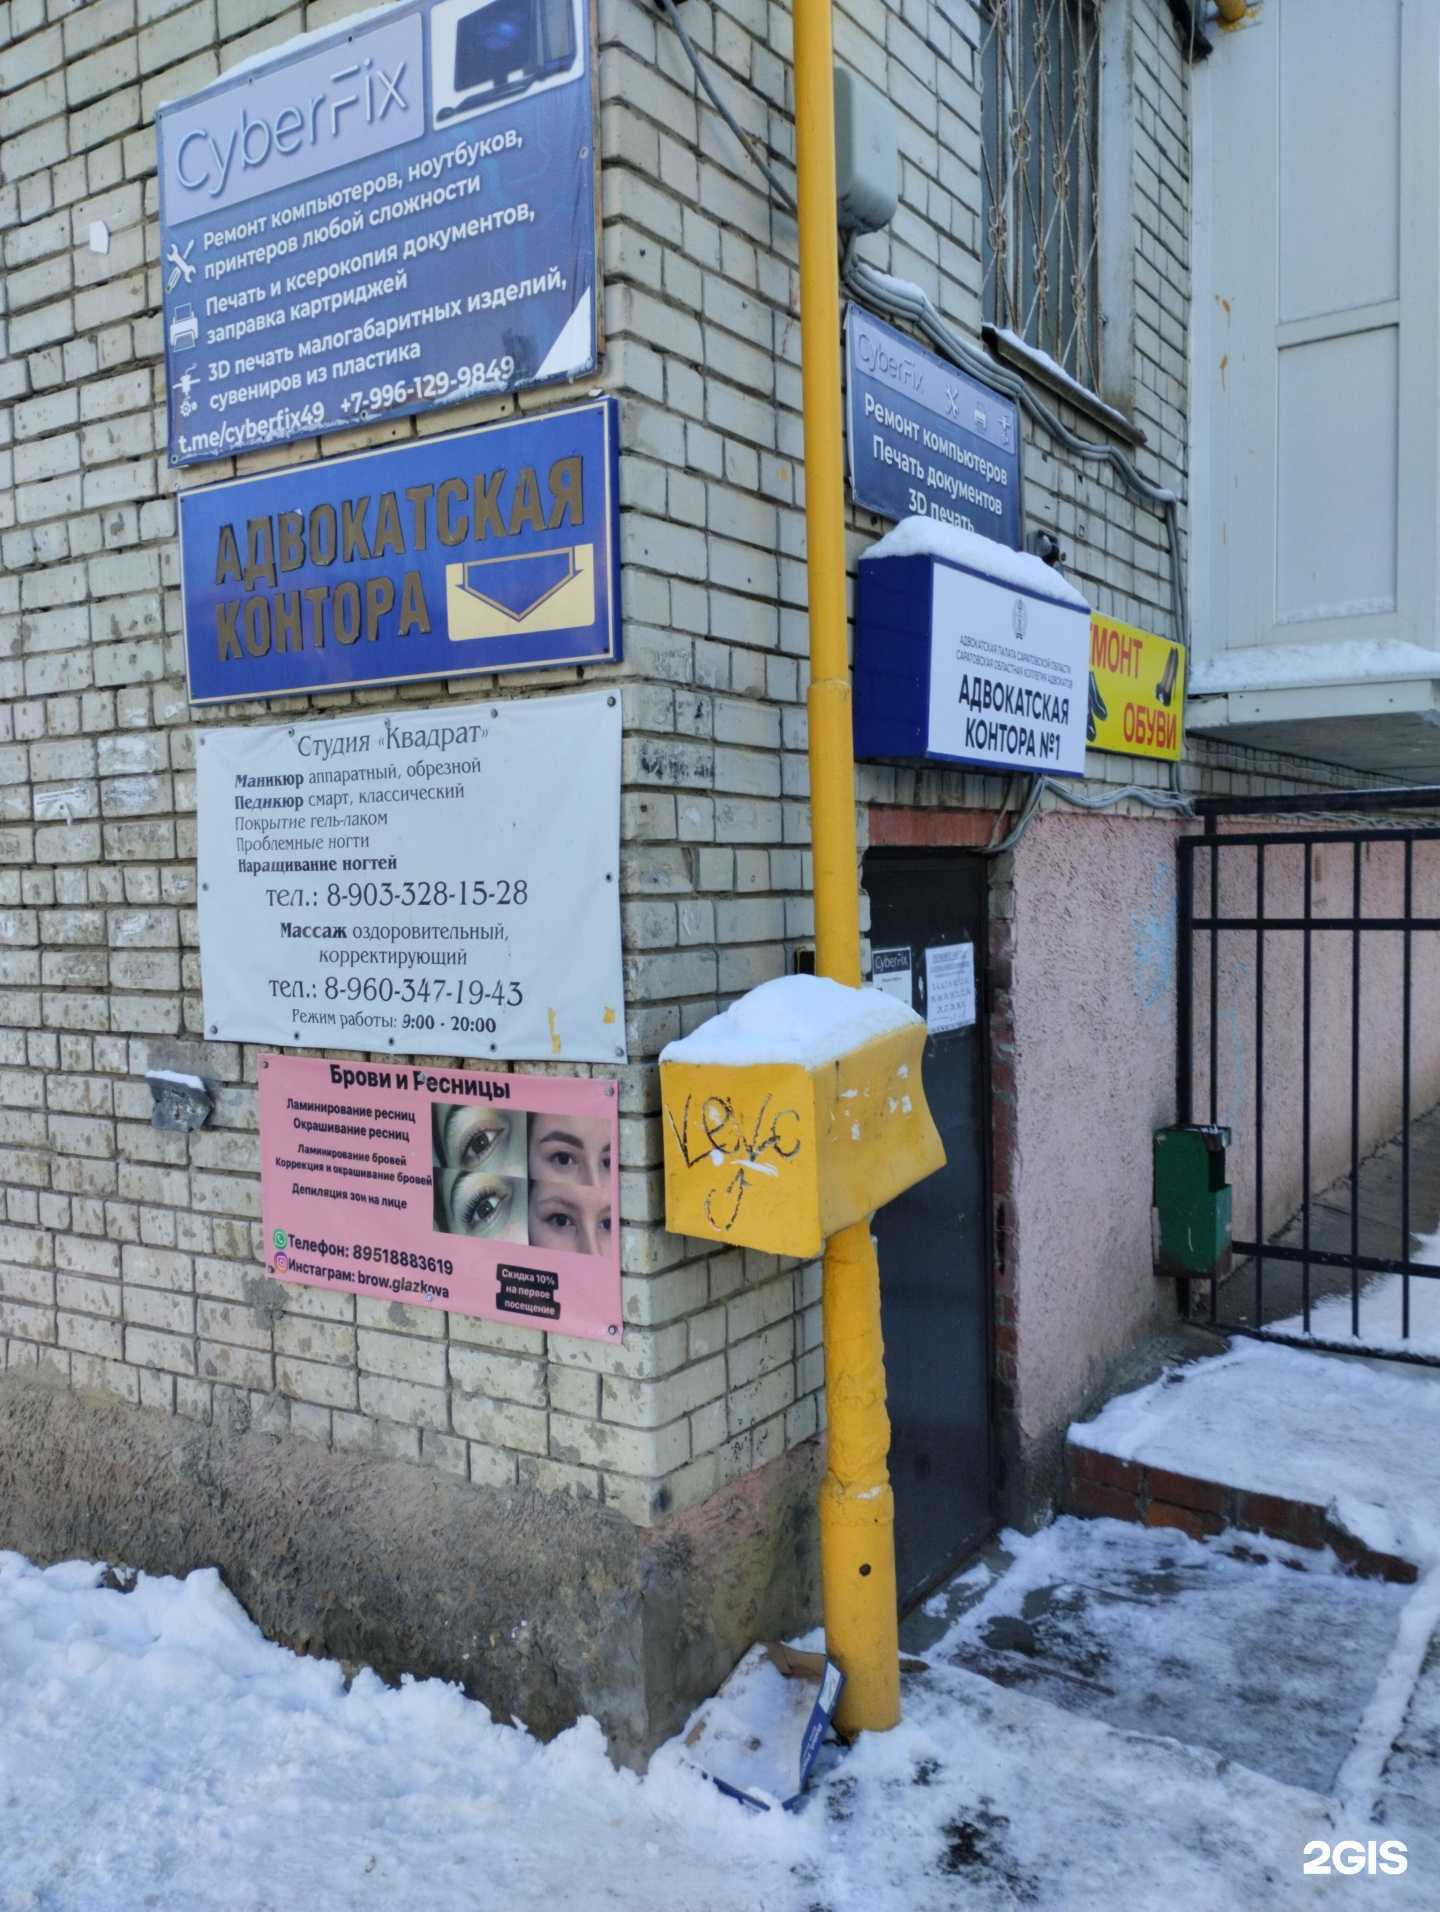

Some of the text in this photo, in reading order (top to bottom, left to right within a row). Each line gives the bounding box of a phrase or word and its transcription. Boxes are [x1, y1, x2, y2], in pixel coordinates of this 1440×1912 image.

[176, 57, 409, 196] CyberFix
[202, 129, 523, 251] Ремонт компьютеров, ноутбуков,
[204, 175, 481, 280] принтеров любой сложности
[206, 201, 535, 317] Печать и ксерокопия документов,
[206, 270, 408, 345] заправка картриджей
[208, 266, 568, 382] 3D печать малогабаритных изделий,
[210, 341, 421, 411] сувениров из пластика
[179, 355, 515, 454] t.me/cyberfix49 +7-996-129-9849
[864, 392, 1008, 485] Ремонт компьютеров
[873, 435, 1003, 515] Печать документов
[908, 488, 928, 515] 3D
[215, 455, 585, 591] АДВОКАТСКАЯ
[216, 570, 431, 662] КОНТОРА
[958, 674, 1069, 725] АДВОКАТСКАЯ
[298, 723, 489, 761] Студия «Квадрат»
[965, 717, 1062, 761] КОНТОРА №1
[1124, 703, 1176, 750] ОБУВИ
[235, 758, 481, 789] Маникюр аппаратный, обрезной
[235, 783, 465, 811] Педикюр смарт, классический
[235, 812, 388, 833] Покрытие гель-лаком
[236, 834, 369, 855] Проблемные ногти
[238, 855, 398, 876] Наращивание ногтей
[265, 879, 529, 908] тел.: 8-903-328-15-28
[280, 922, 509, 945] Массаж оздоровительный,
[319, 948, 468, 968] корректирующий
[268, 976, 524, 1006] тел.: 8-960-347-19-43
[292, 1008, 336, 1025] Режим
[340, 1012, 398, 1029] работы:
[401, 1014, 435, 1030] 9:00
[451, 1016, 497, 1033] 20:00
[330, 1065, 511, 1099] Брови и Ресницы
[287, 1098, 416, 1123] Ламинирование ресниц
[293, 1118, 410, 1143] Окрашивание ресниц
[298, 1144, 407, 1166] Ламинирование бровей
[275, 1157, 324, 1172] Коррекция
[333, 1167, 395, 1181] окрашивание
[397, 1172, 433, 1186] бровей
[292, 1183, 407, 1211] Депиляция зон на лице
[288, 1234, 454, 1275] Телефон: 89518883619
[288, 1258, 449, 1298] Инстаграм: brow.glazkova
[502, 1268, 555, 1286] Скидка 10%
[506, 1285, 550, 1299] на первое
[504, 1300, 556, 1315] посещение
